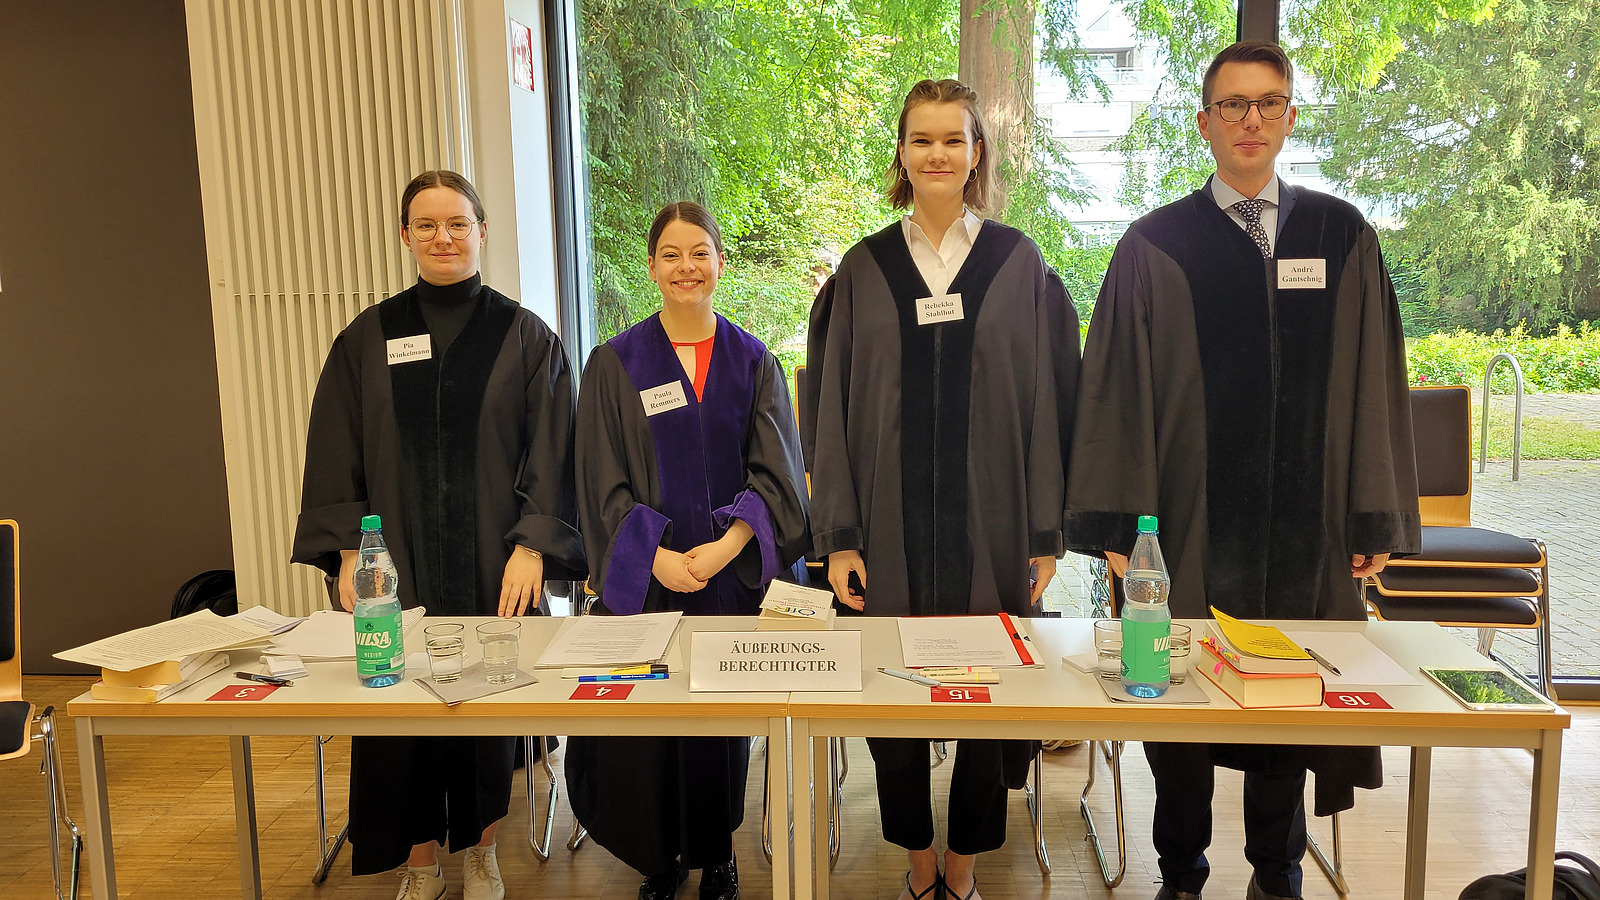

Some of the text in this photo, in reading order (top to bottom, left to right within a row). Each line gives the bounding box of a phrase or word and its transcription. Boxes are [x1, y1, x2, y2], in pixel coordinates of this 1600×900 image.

[1282, 275, 1322, 283] Gantschnig
[924, 301, 954, 310] Rebekka
[925, 309, 955, 318] Stahlhut
[389, 349, 430, 359] Winkelmann
[653, 390, 672, 400] Paula
[650, 397, 681, 409] Remmers
[355, 631, 392, 649] VILSA
[1153, 635, 1170, 652] VIL
[718, 660, 838, 672] BERECHTIGTER
[234, 687, 256, 699] 3
[595, 686, 612, 697] 4
[949, 689, 974, 700] 15
[1338, 695, 1371, 706] 16
